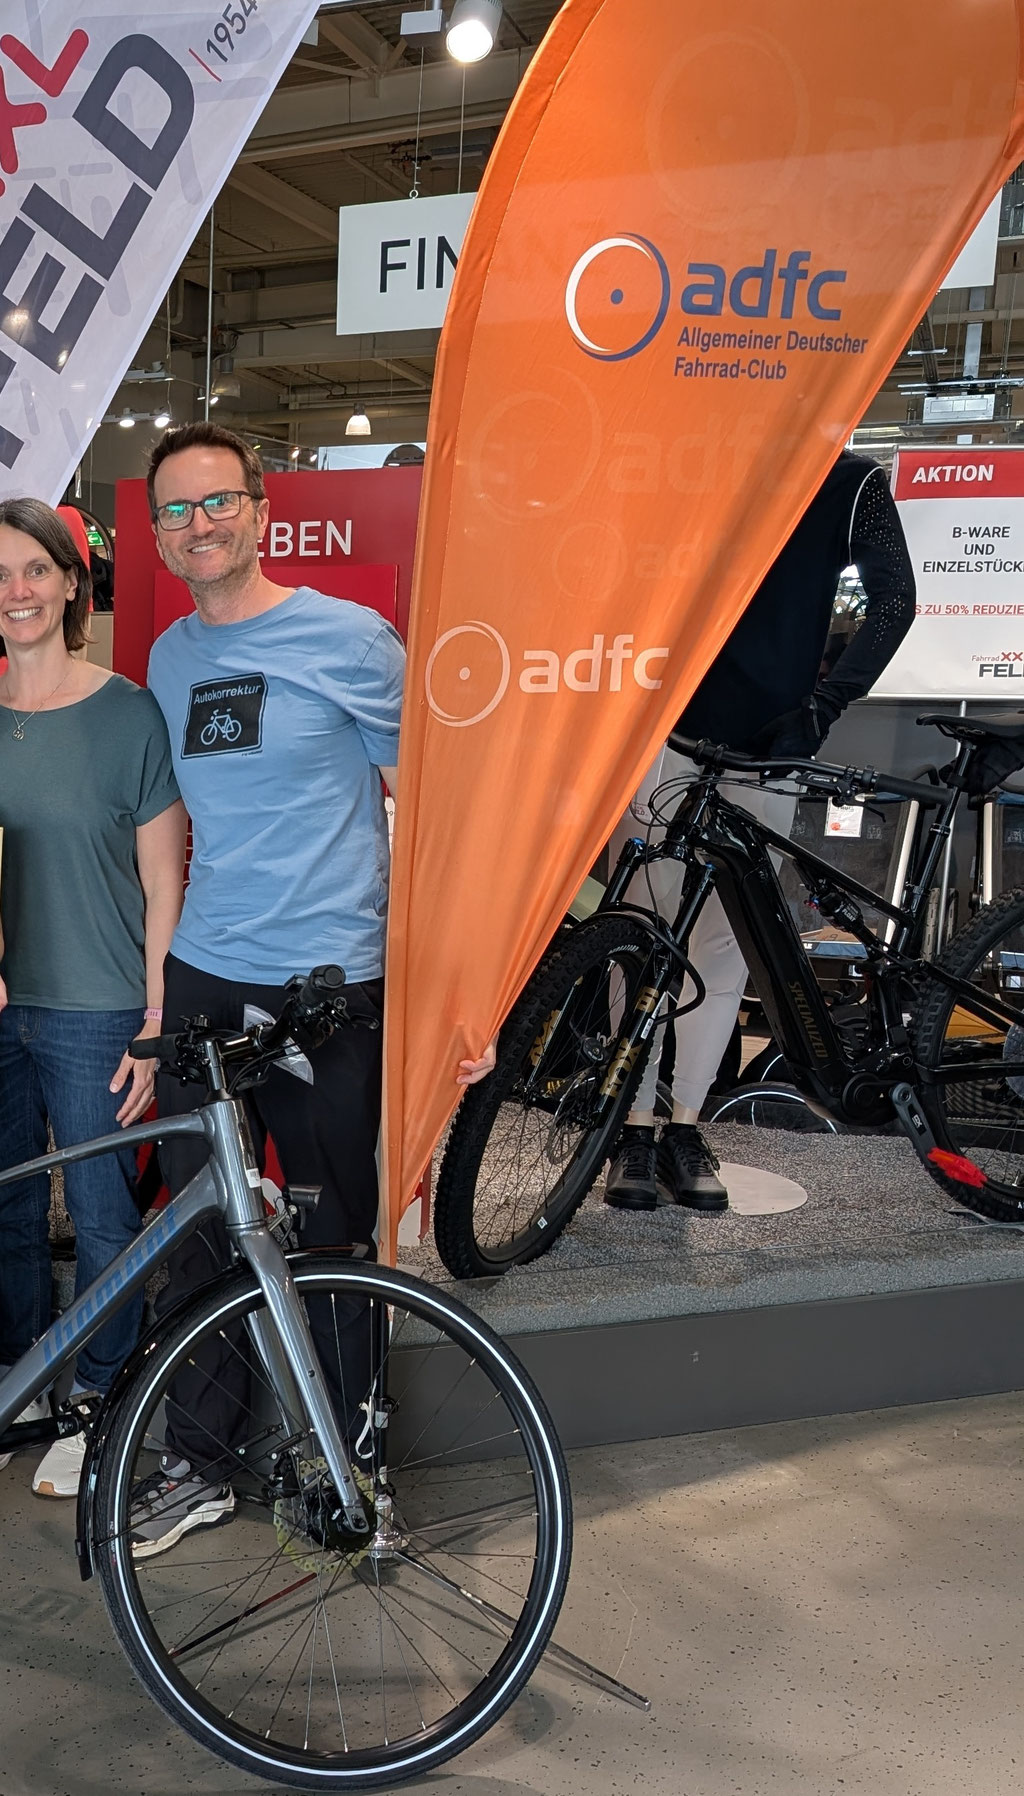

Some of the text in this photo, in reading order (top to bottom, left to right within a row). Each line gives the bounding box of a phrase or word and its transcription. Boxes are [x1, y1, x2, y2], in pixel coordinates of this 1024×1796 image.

[206, 0, 258, 63] 1954
[680, 248, 847, 321] adfc
[677, 326, 868, 355] Allgemeiner Deutscher
[674, 357, 788, 381] Fahrrad-Club
[912, 464, 994, 483] AKTION
[257, 520, 352, 557] BEN
[952, 527, 1010, 538] B-WARE
[964, 544, 995, 555] UND
[923, 558, 1024, 573] EINZELSTÜCK
[925, 604, 942, 614] ZU
[945, 604, 969, 614] 50%
[518, 634, 670, 693] adfc
[979, 664, 1024, 677] FEL
[194, 684, 262, 705] Autokorrektur
[787, 981, 829, 1058] SPECIALIZED
[599, 1037, 643, 1097] FOX
